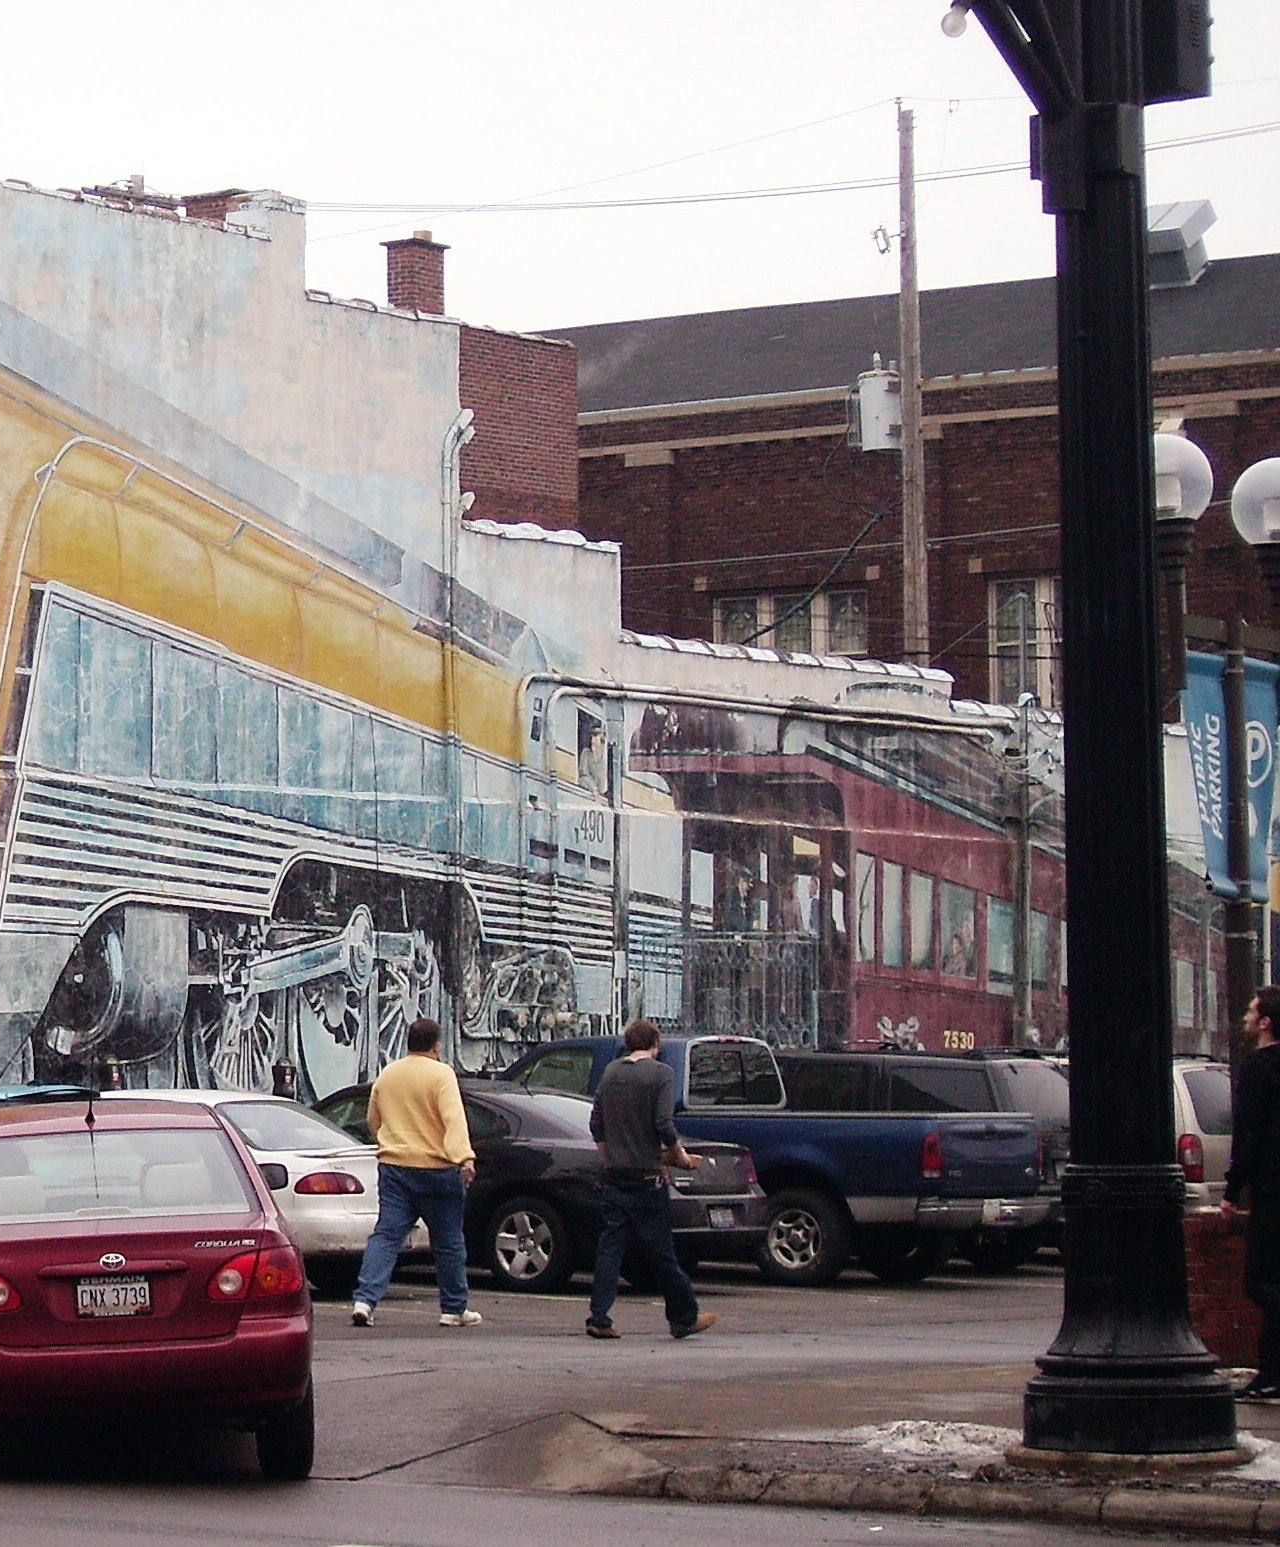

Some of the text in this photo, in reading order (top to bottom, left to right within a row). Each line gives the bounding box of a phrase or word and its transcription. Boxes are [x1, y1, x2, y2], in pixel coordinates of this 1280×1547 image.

[1190, 722, 1211, 825] PUBLIC
[1205, 712, 1224, 840] PARKING
[1246, 729, 1267, 776] P
[943, 1030, 975, 1050] 7530
[80, 1286, 148, 1308] CNX 3739
